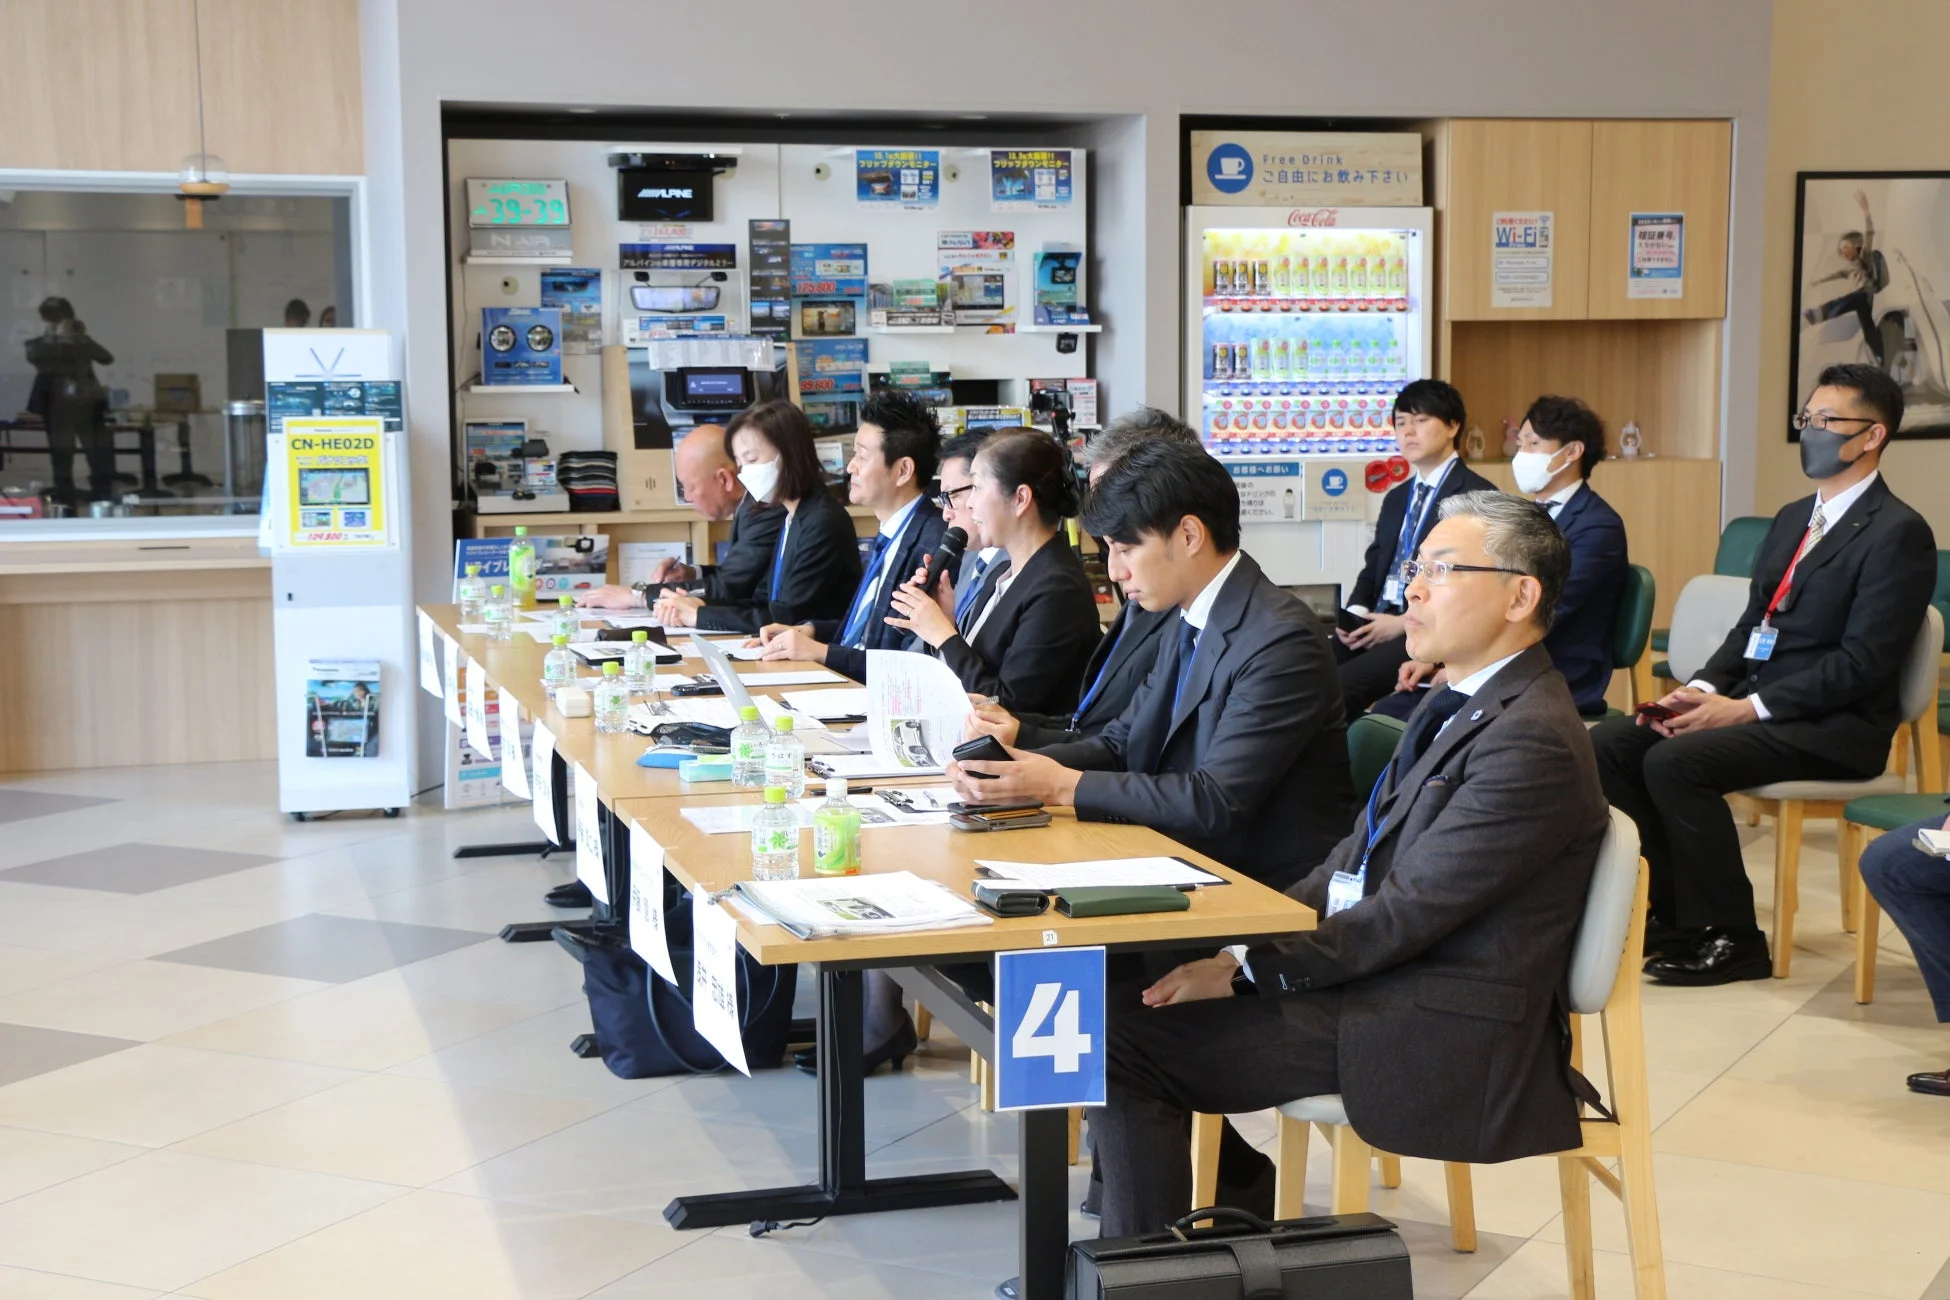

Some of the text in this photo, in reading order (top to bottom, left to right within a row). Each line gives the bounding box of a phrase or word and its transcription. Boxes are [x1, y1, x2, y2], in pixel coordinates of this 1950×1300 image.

[1263, 154, 1343, 165] Free Drink
[1262, 170, 1408, 184] ご自由にお飲み下さい
[638, 188, 693, 198] ALPINE
[1496, 226, 1537, 244] Wi-Fi
[291, 438, 374, 451] CN-HE02D
[1232, 464, 1289, 475] お客様へお願い
[1046, 933, 1055, 942] 21
[1012, 982, 1092, 1074] 4
